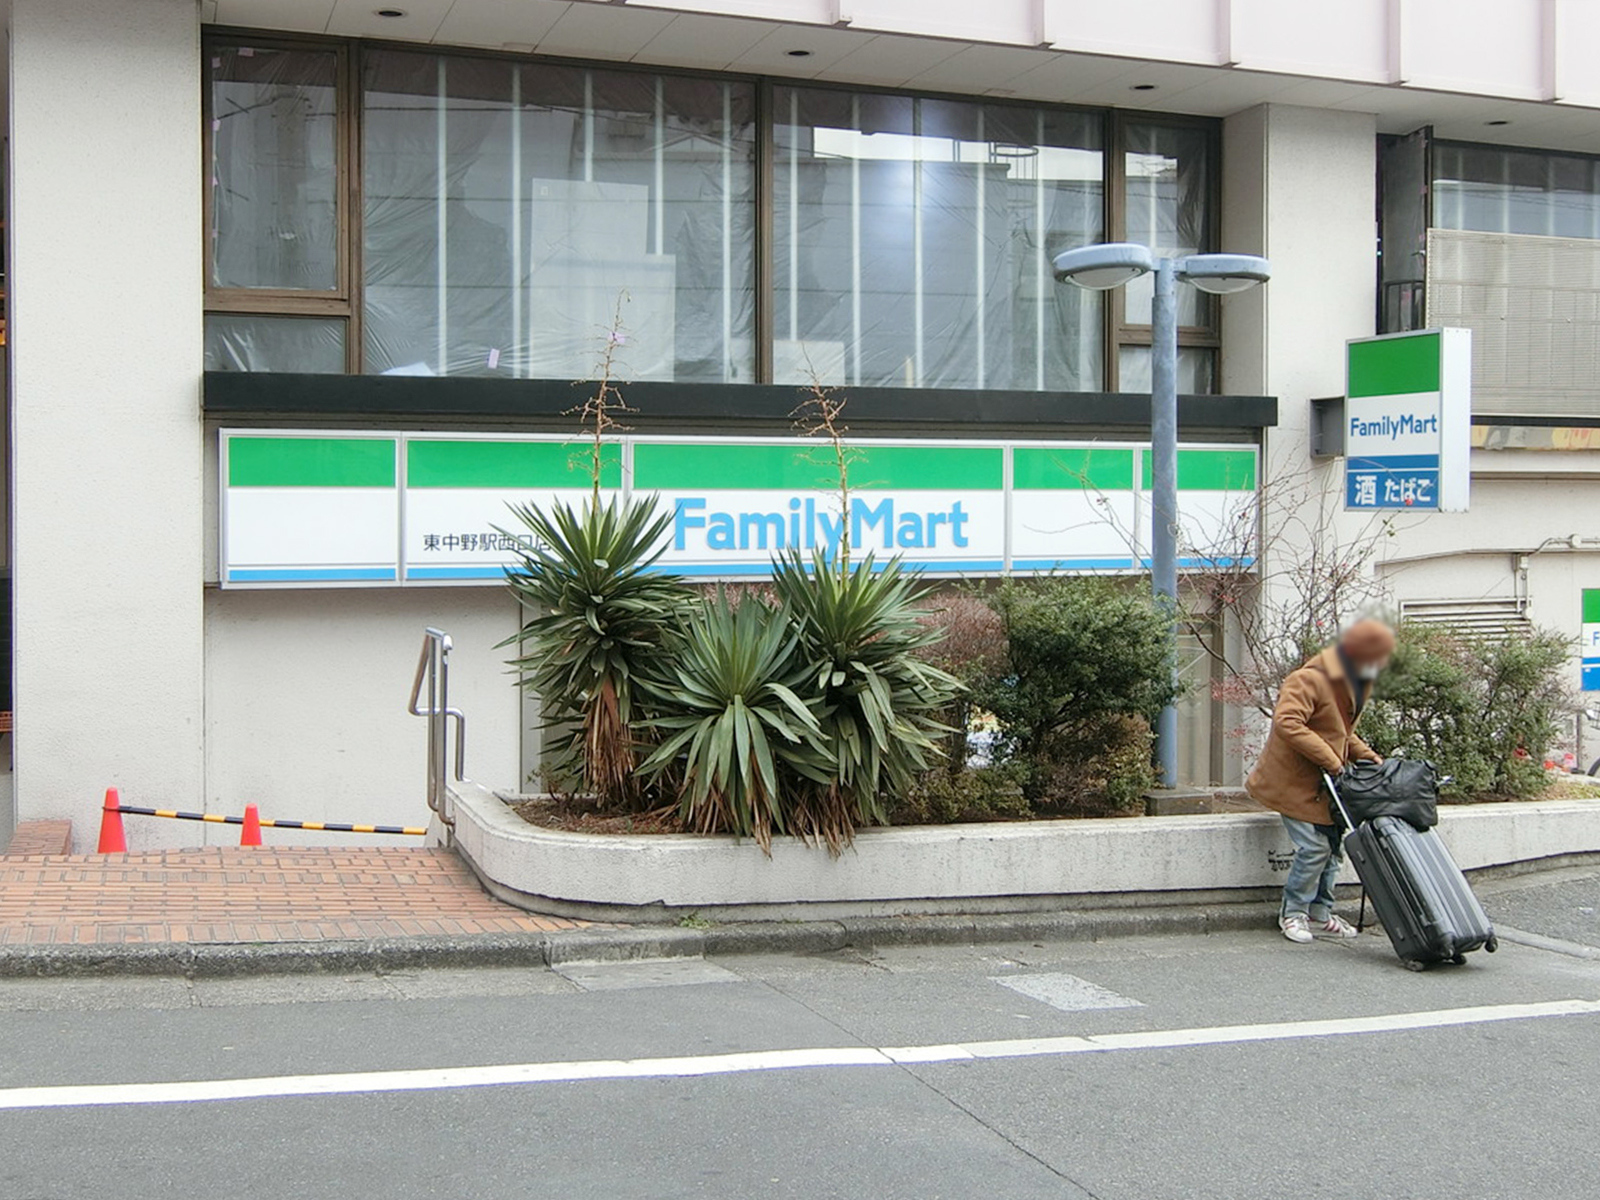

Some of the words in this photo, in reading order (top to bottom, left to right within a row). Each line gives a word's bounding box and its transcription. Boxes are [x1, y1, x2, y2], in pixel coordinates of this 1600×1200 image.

[1350, 414, 1437, 441] FamilyMart
[1354, 475, 1377, 505] 酒
[1384, 477, 1431, 502] たばこ
[674, 497, 968, 563] FamilyMart
